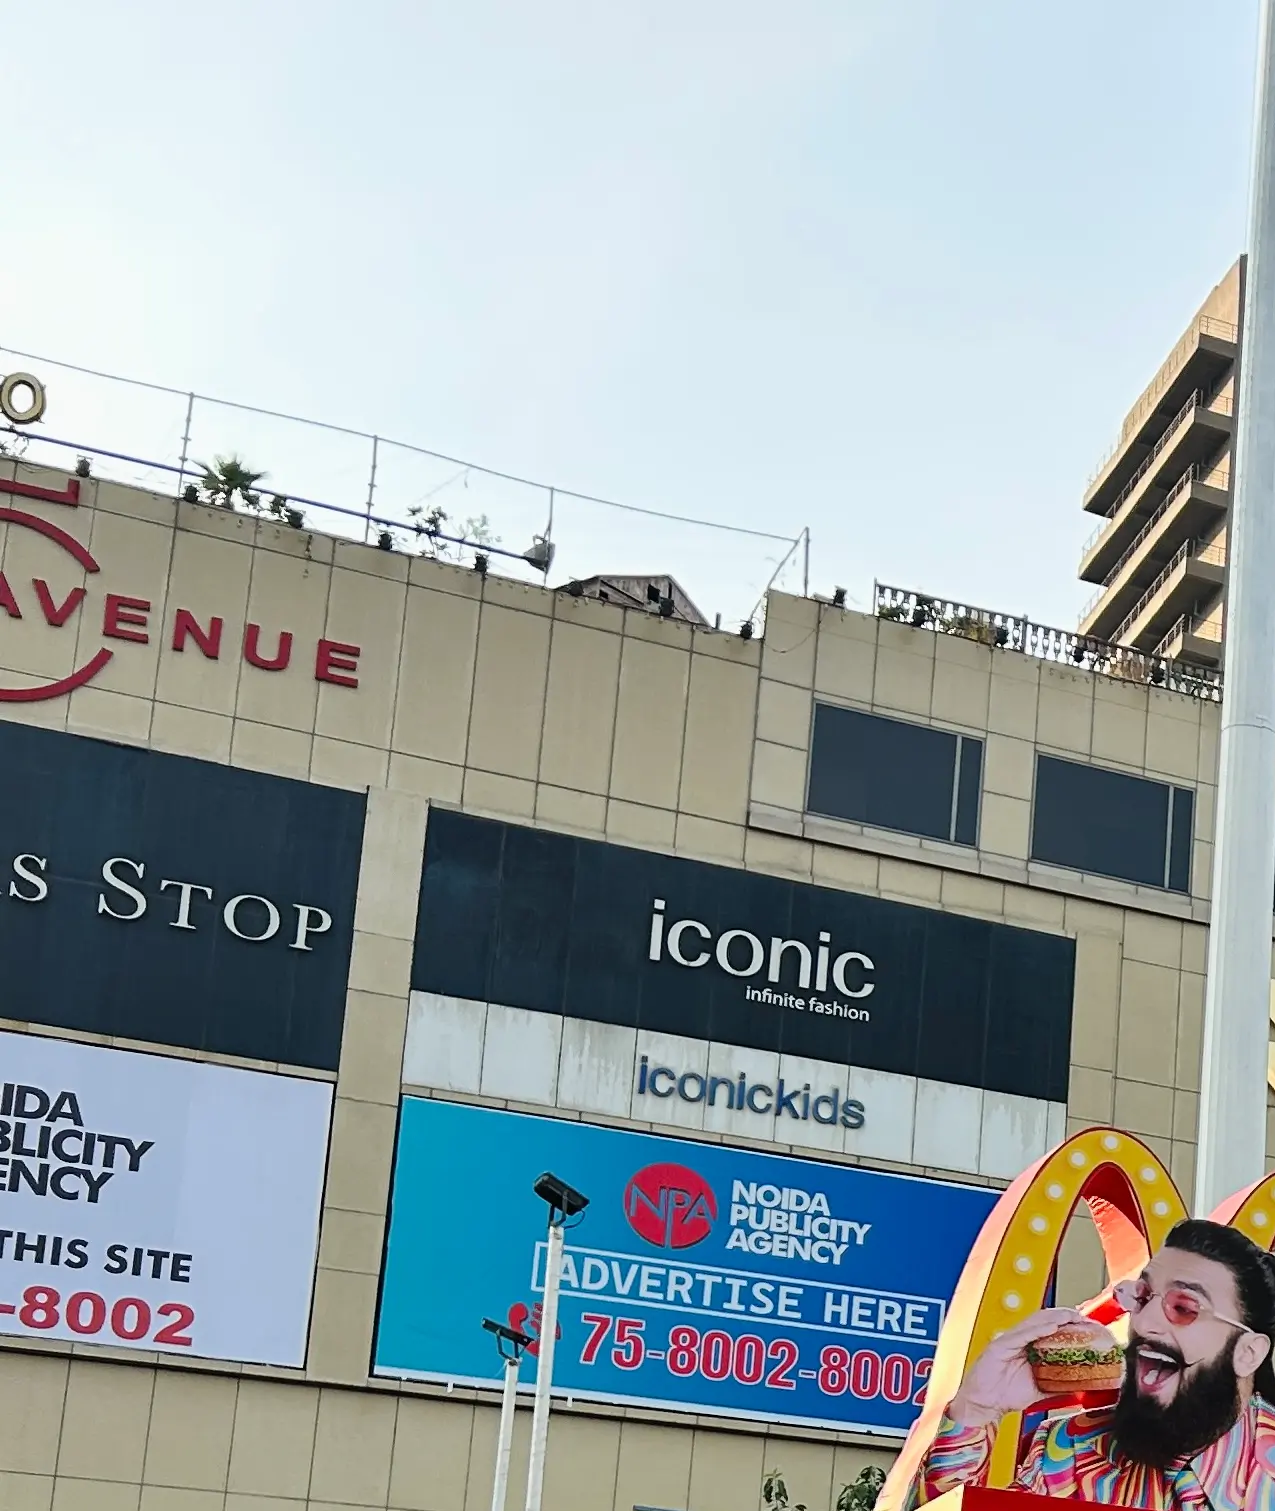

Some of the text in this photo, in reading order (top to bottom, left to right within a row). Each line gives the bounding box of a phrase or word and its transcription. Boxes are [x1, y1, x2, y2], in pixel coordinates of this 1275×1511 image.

[649, 898, 876, 998] iconic
[745, 985, 871, 1022] infinite fashion
[637, 1055, 866, 1129] iconickids
[731, 1180, 831, 1217] NOIDA
[728, 1203, 872, 1246] PUBLICITY
[103, 1244, 194, 1283] SITE
[725, 1228, 850, 1266] AGENCY
[558, 1258, 929, 1336] ADVERTISE HERE
